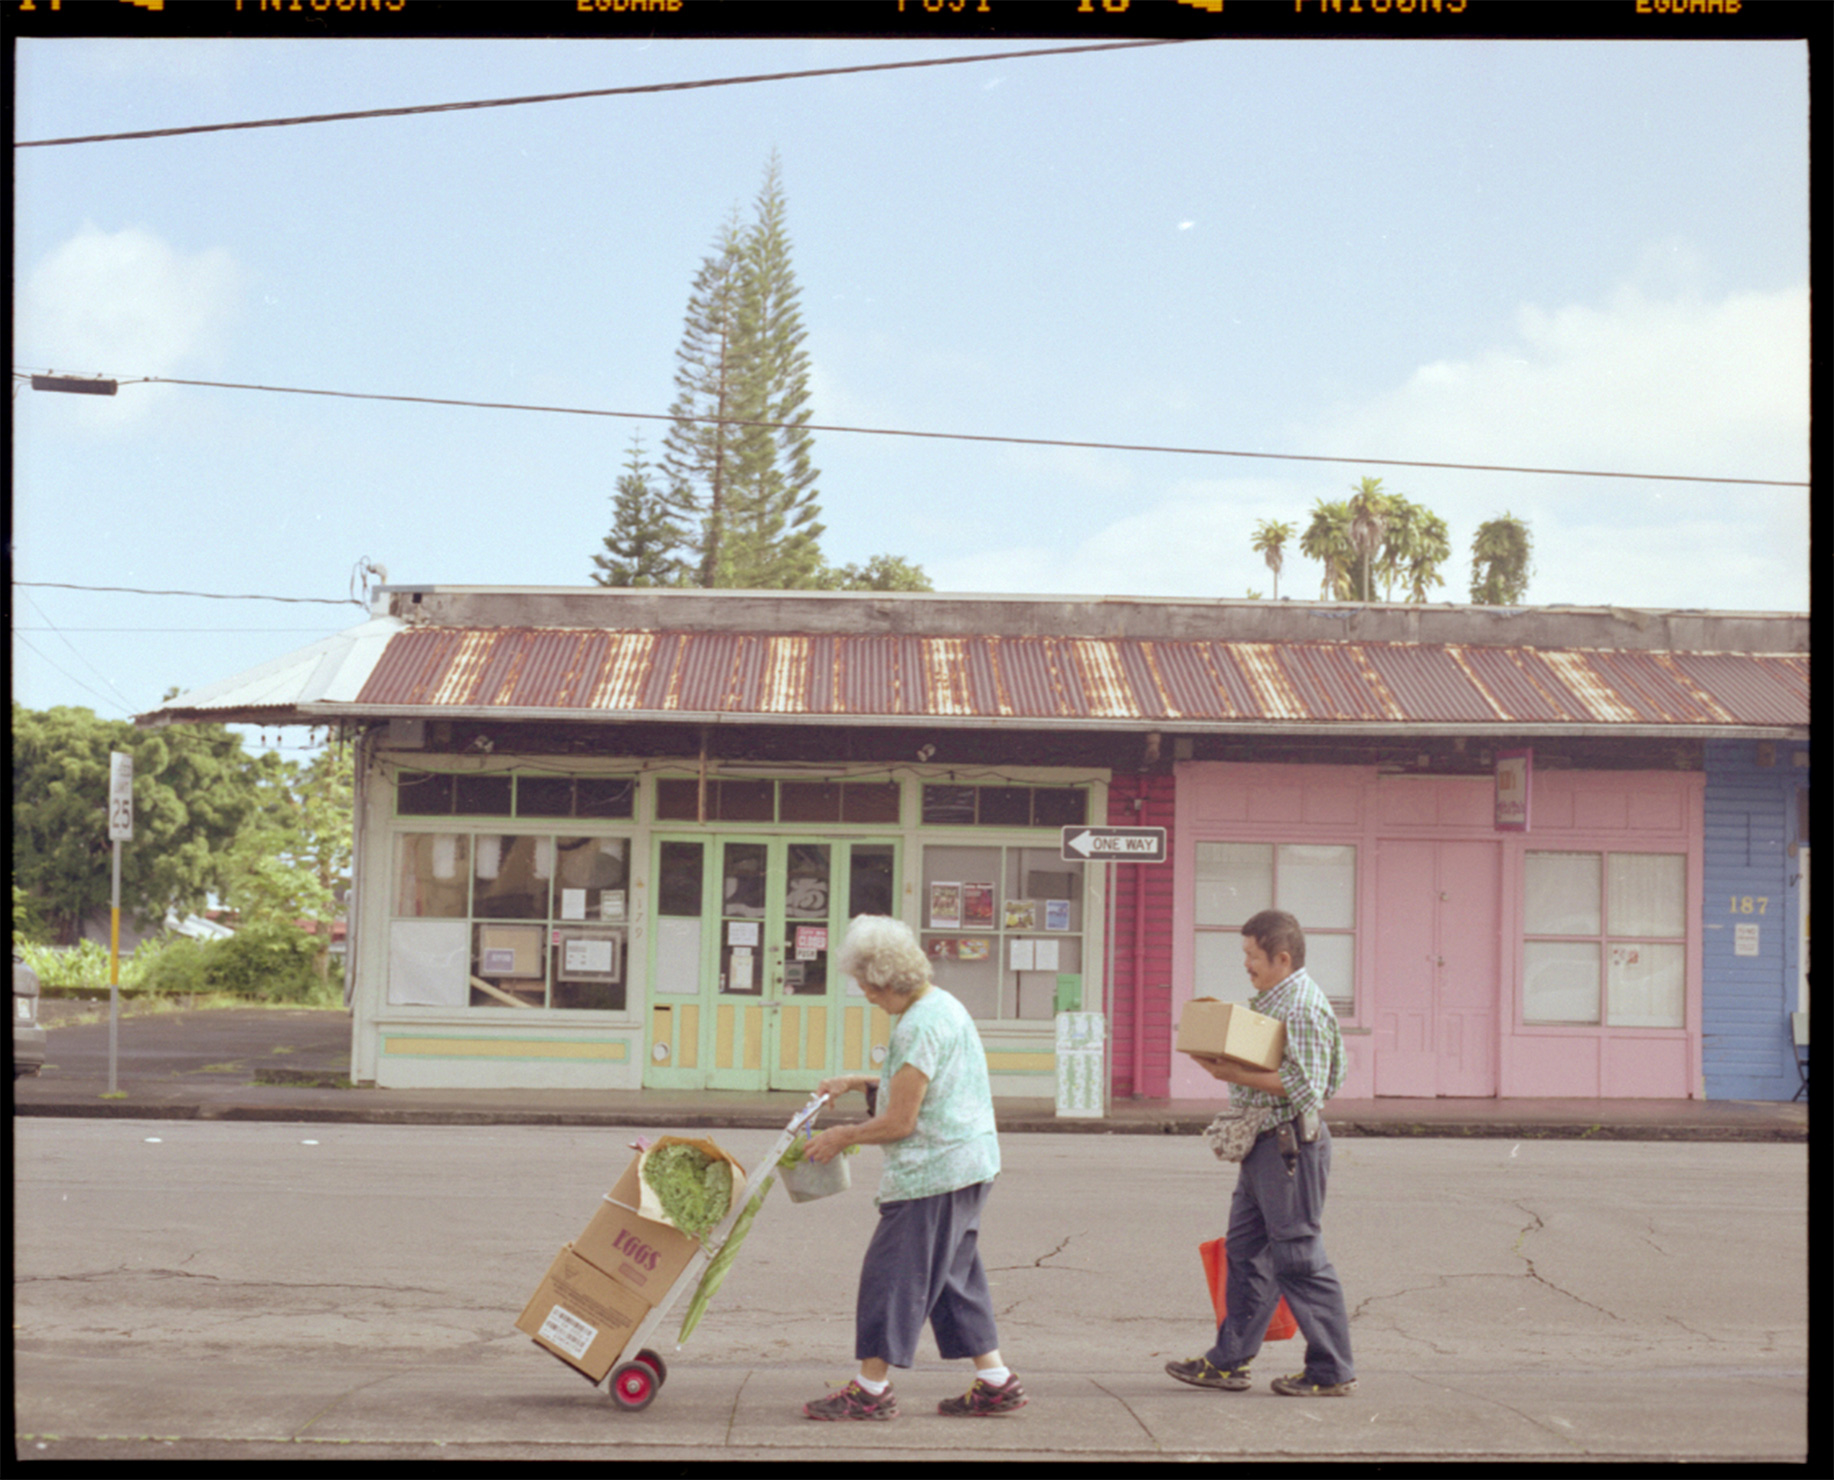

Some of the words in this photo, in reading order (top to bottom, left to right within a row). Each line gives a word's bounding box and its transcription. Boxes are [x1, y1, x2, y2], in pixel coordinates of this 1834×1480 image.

[112, 798, 130, 829] 25
[1093, 837, 1121, 851] ONE
[1125, 837, 1154, 851] WAY
[1729, 896, 1769, 915] 187
[612, 1228, 662, 1271] EGGS
